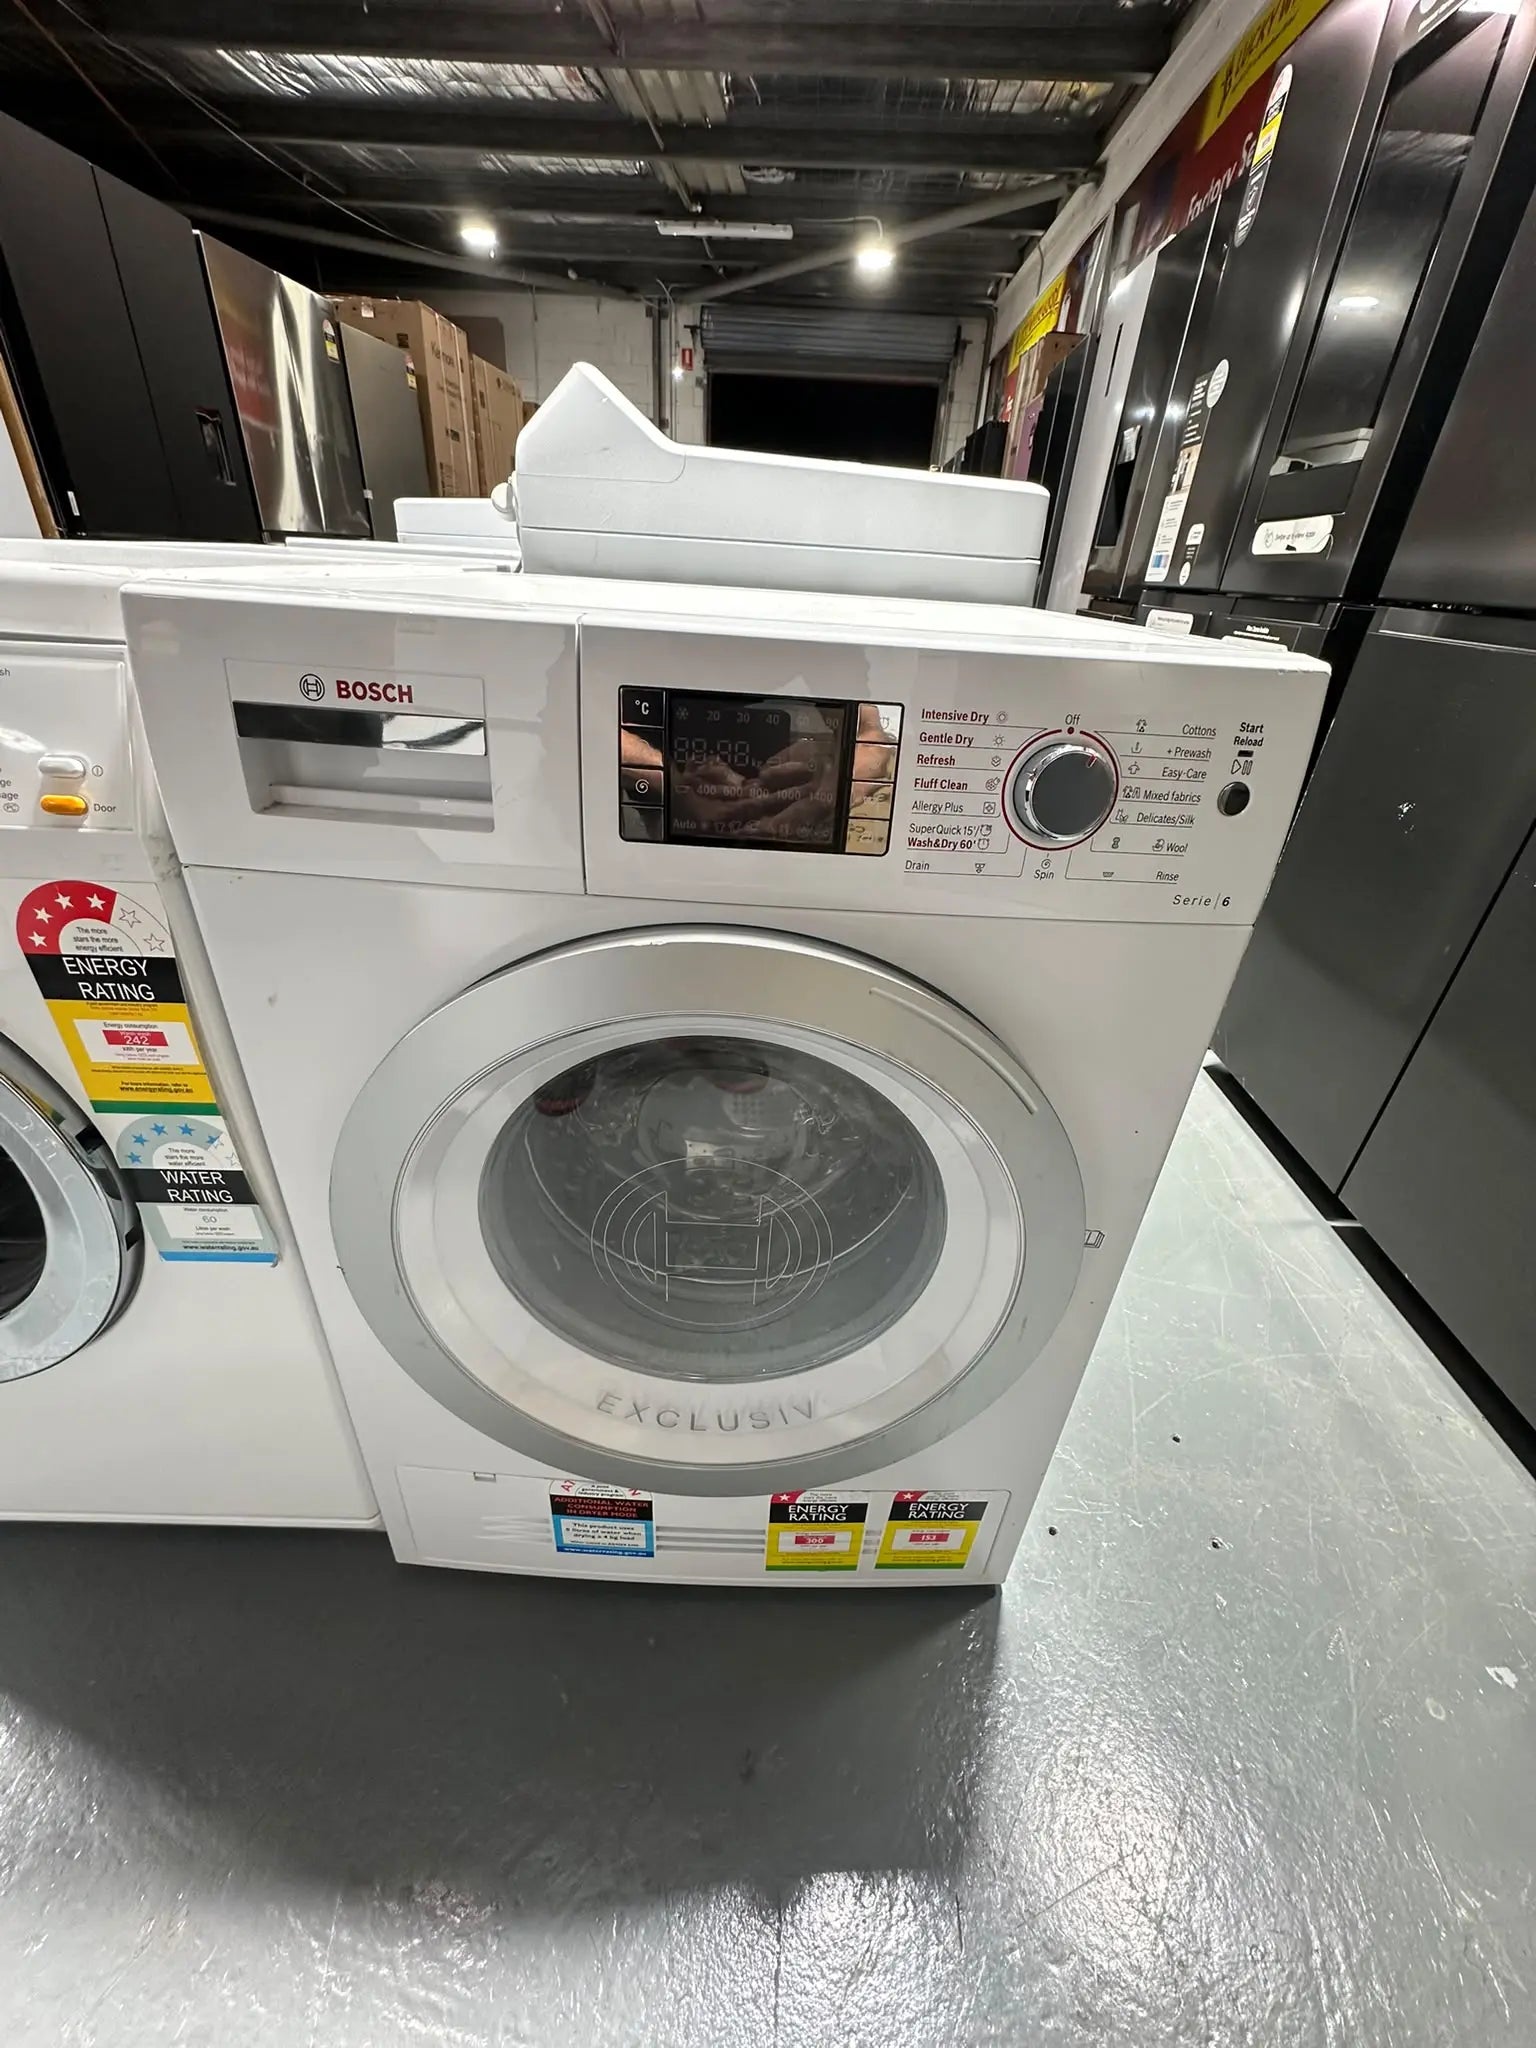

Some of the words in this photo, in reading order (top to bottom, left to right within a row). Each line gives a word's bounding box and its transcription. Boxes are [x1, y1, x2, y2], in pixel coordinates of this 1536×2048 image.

[336, 680, 413, 703] BOSCH
[921, 708, 968, 721] Intensive
[970, 711, 989, 725] Dry
[1065, 714, 1081, 726] Off
[1182, 724, 1217, 737] Cottons
[1240, 722, 1264, 734] Start
[919, 731, 954, 744] Gentle
[955, 734, 974, 747] Dry
[1233, 736, 1264, 747] Reload
[1174, 747, 1212, 759] Prewash
[917, 754, 956, 766] Refresh
[1161, 766, 1207, 780] Easy-Care
[914, 778, 939, 789] Fluff
[940, 779, 968, 790] Clean
[1143, 790, 1170, 801] Mixed
[1170, 791, 1202, 803] fabrics
[94, 803, 116, 812] Door
[912, 800, 943, 814] Allergy
[944, 802, 964, 813] Plus
[1136, 812, 1195, 826] Delicates/Silk
[909, 823, 961, 835] SuperQuick
[907, 837, 959, 851] Wash&Dry
[1166, 843, 1189, 853] Wool
[905, 860, 930, 871] Drain
[1033, 869, 1055, 881] Spin
[1155, 871, 1180, 882] Rinse
[1172, 894, 1212, 907] Serie
[76, 926, 90, 934] The
[75, 945, 98, 953] energy
[62, 957, 148, 977] ENERGY
[77, 981, 155, 1001] RATING
[103, 1021, 123, 1029] Energy
[123, 1035, 150, 1045] 242
[160, 1170, 226, 1185] WATER
[167, 1188, 234, 1203] RATING
[202, 1215, 218, 1224] 60
[596, 1391, 813, 1432] EXCLUSIV
[554, 1497, 613, 1506] ADDITIONAL
[615, 1500, 649, 1508] WATER
[567, 1503, 638, 1513] CONSUMPTION
[788, 1504, 849, 1513] ENERGY
[909, 1503, 969, 1511] ENERGY
[579, 1509, 610, 1517] DRYER
[610, 1510, 639, 1518] MODE
[789, 1513, 847, 1522] RATING
[908, 1511, 966, 1519] RATING
